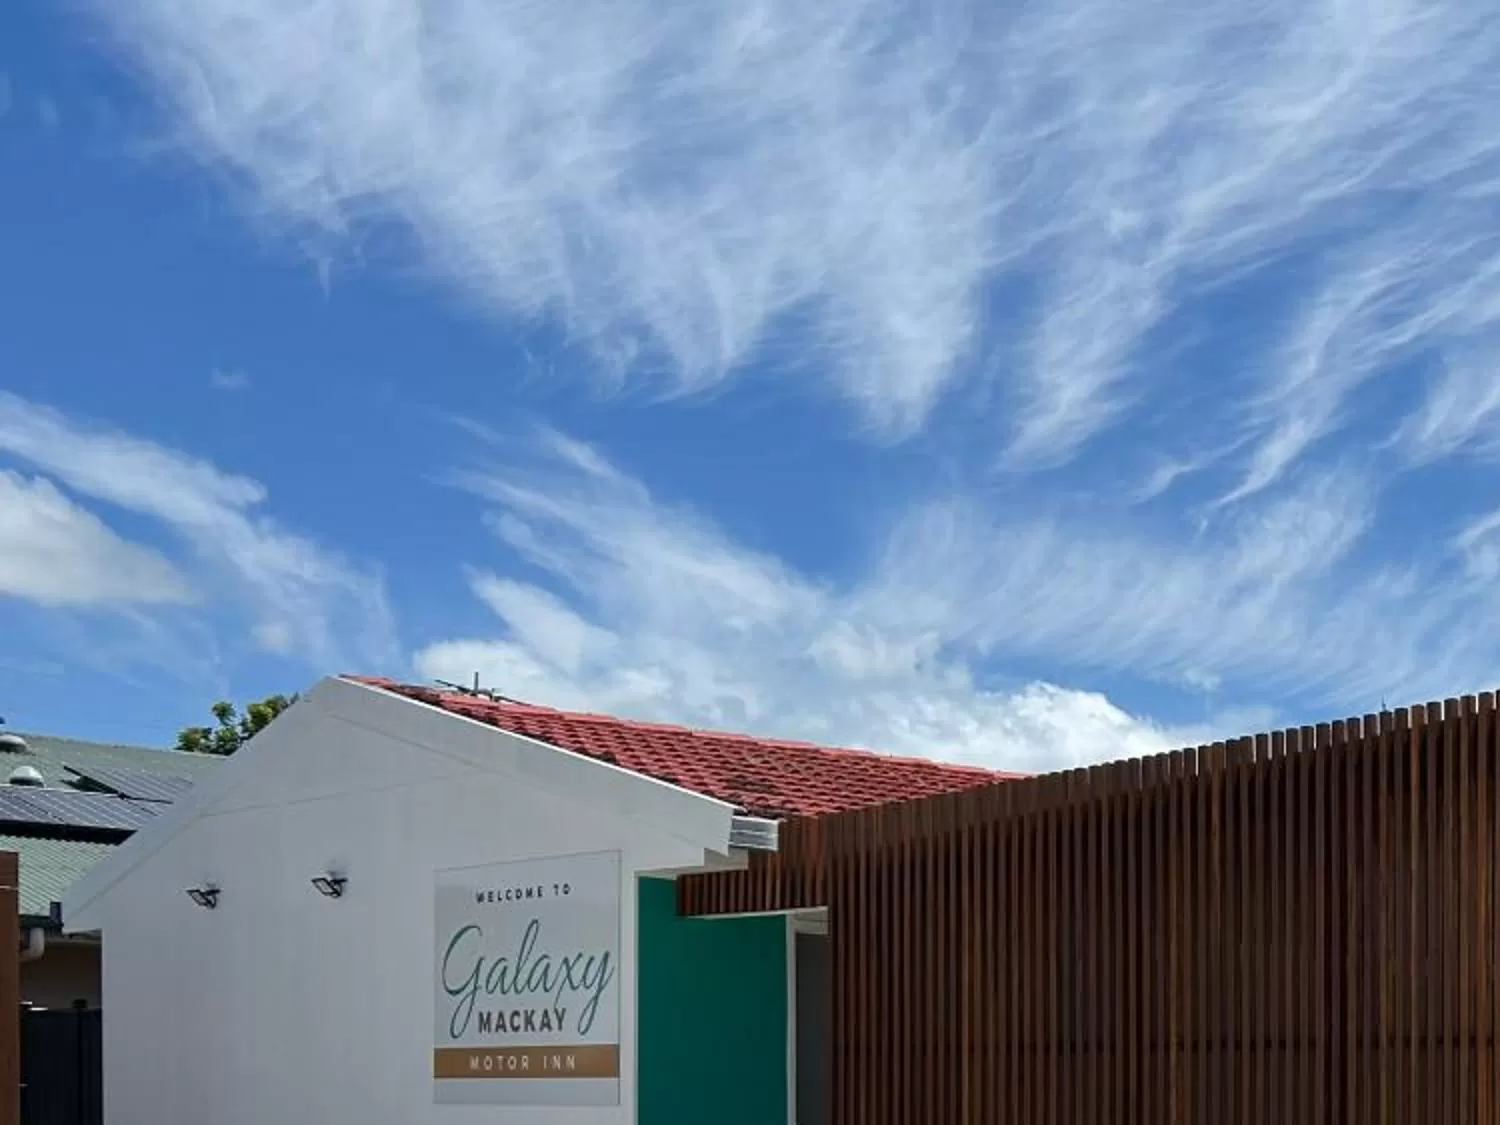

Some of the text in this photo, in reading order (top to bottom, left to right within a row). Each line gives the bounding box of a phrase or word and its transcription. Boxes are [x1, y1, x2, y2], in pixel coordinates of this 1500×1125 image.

[476, 883, 571, 902] WELCOME TO
[443, 919, 614, 1038] Galaxy
[478, 1008, 567, 1033] MACKAY
[469, 1055, 576, 1071] MOTOR INN
